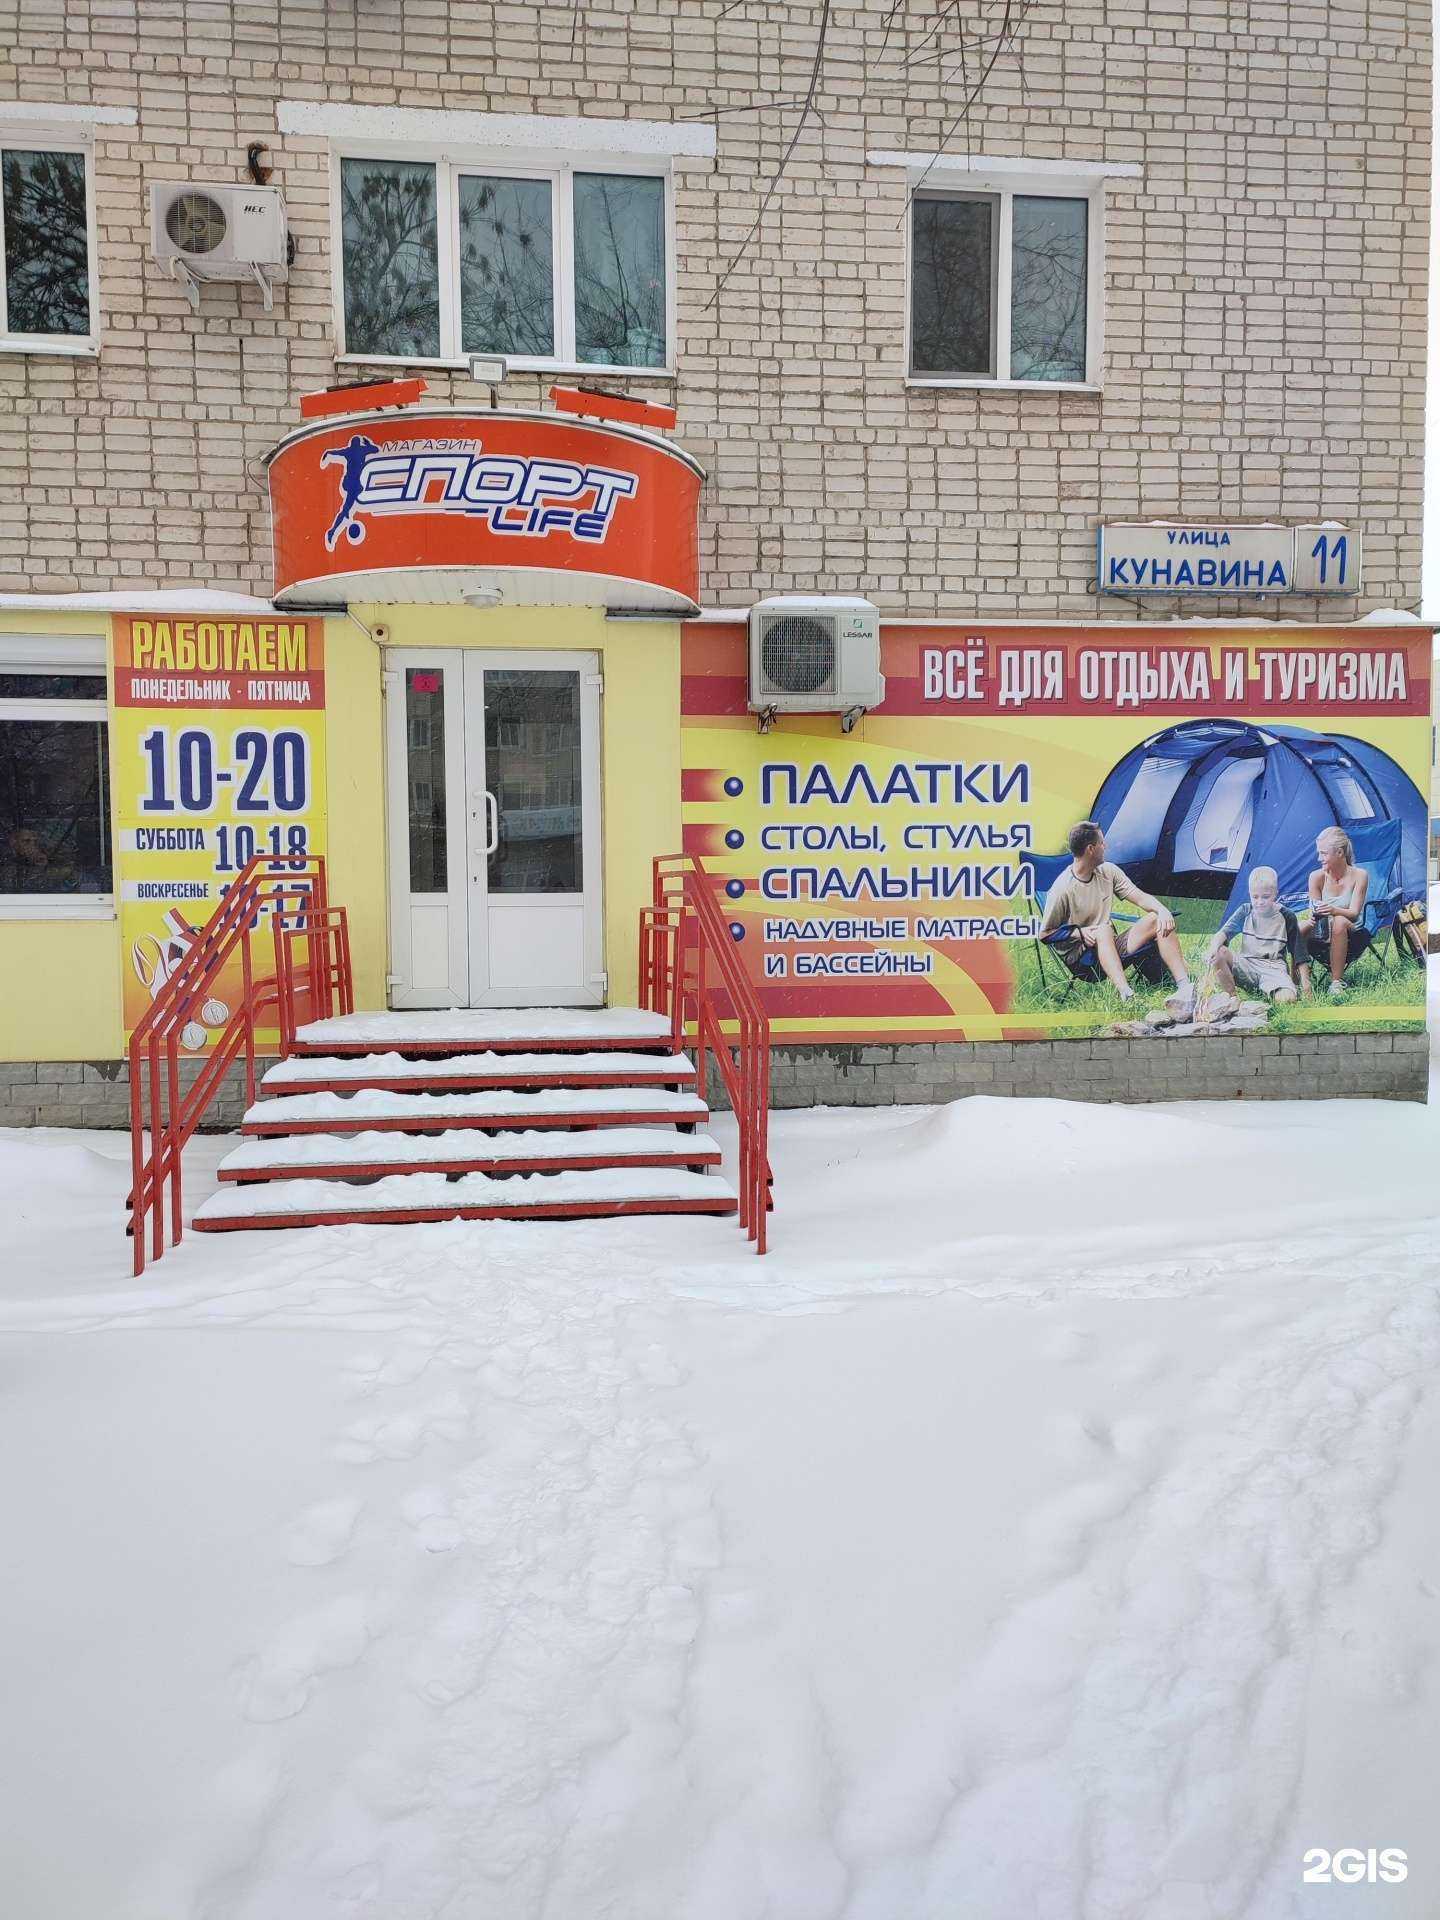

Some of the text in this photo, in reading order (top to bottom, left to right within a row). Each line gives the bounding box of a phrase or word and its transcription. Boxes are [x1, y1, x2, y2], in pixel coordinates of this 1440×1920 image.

[382, 439, 478, 453] МАГАЗИН
[355, 453, 636, 516] СПОРТ
[491, 506, 607, 538] LIFE
[1167, 530, 1231, 548] УЛИЦА
[1109, 557, 1287, 587] КУНАВИНА
[1311, 534, 1348, 585] 11
[131, 621, 307, 672] РАБОТАЕМ
[924, 638, 1407, 708] ВСЁ ДЛЯ ОТДЫХА И ТУРИЗМА
[131, 678, 232, 702] ПОНЕДЕЛЬНИК
[247, 680, 311, 704] ПЯТНИЦА
[143, 731, 306, 811] 10-20
[762, 763, 1030, 804] ПАЛАТКИ
[136, 825, 307, 871] СУББОТА 10-18
[761, 824, 1032, 853] СТОЛЫ, СТУЛЬЯ
[137, 883, 209, 898] ВОСКРЕСЕНЬЕ
[762, 865, 1033, 900] СПАЛЬНИКИ
[766, 918, 1037, 940] НАДУВНЫЕ МАТРАСЫ
[767, 951, 932, 975] И БАССЕЙНЫ
